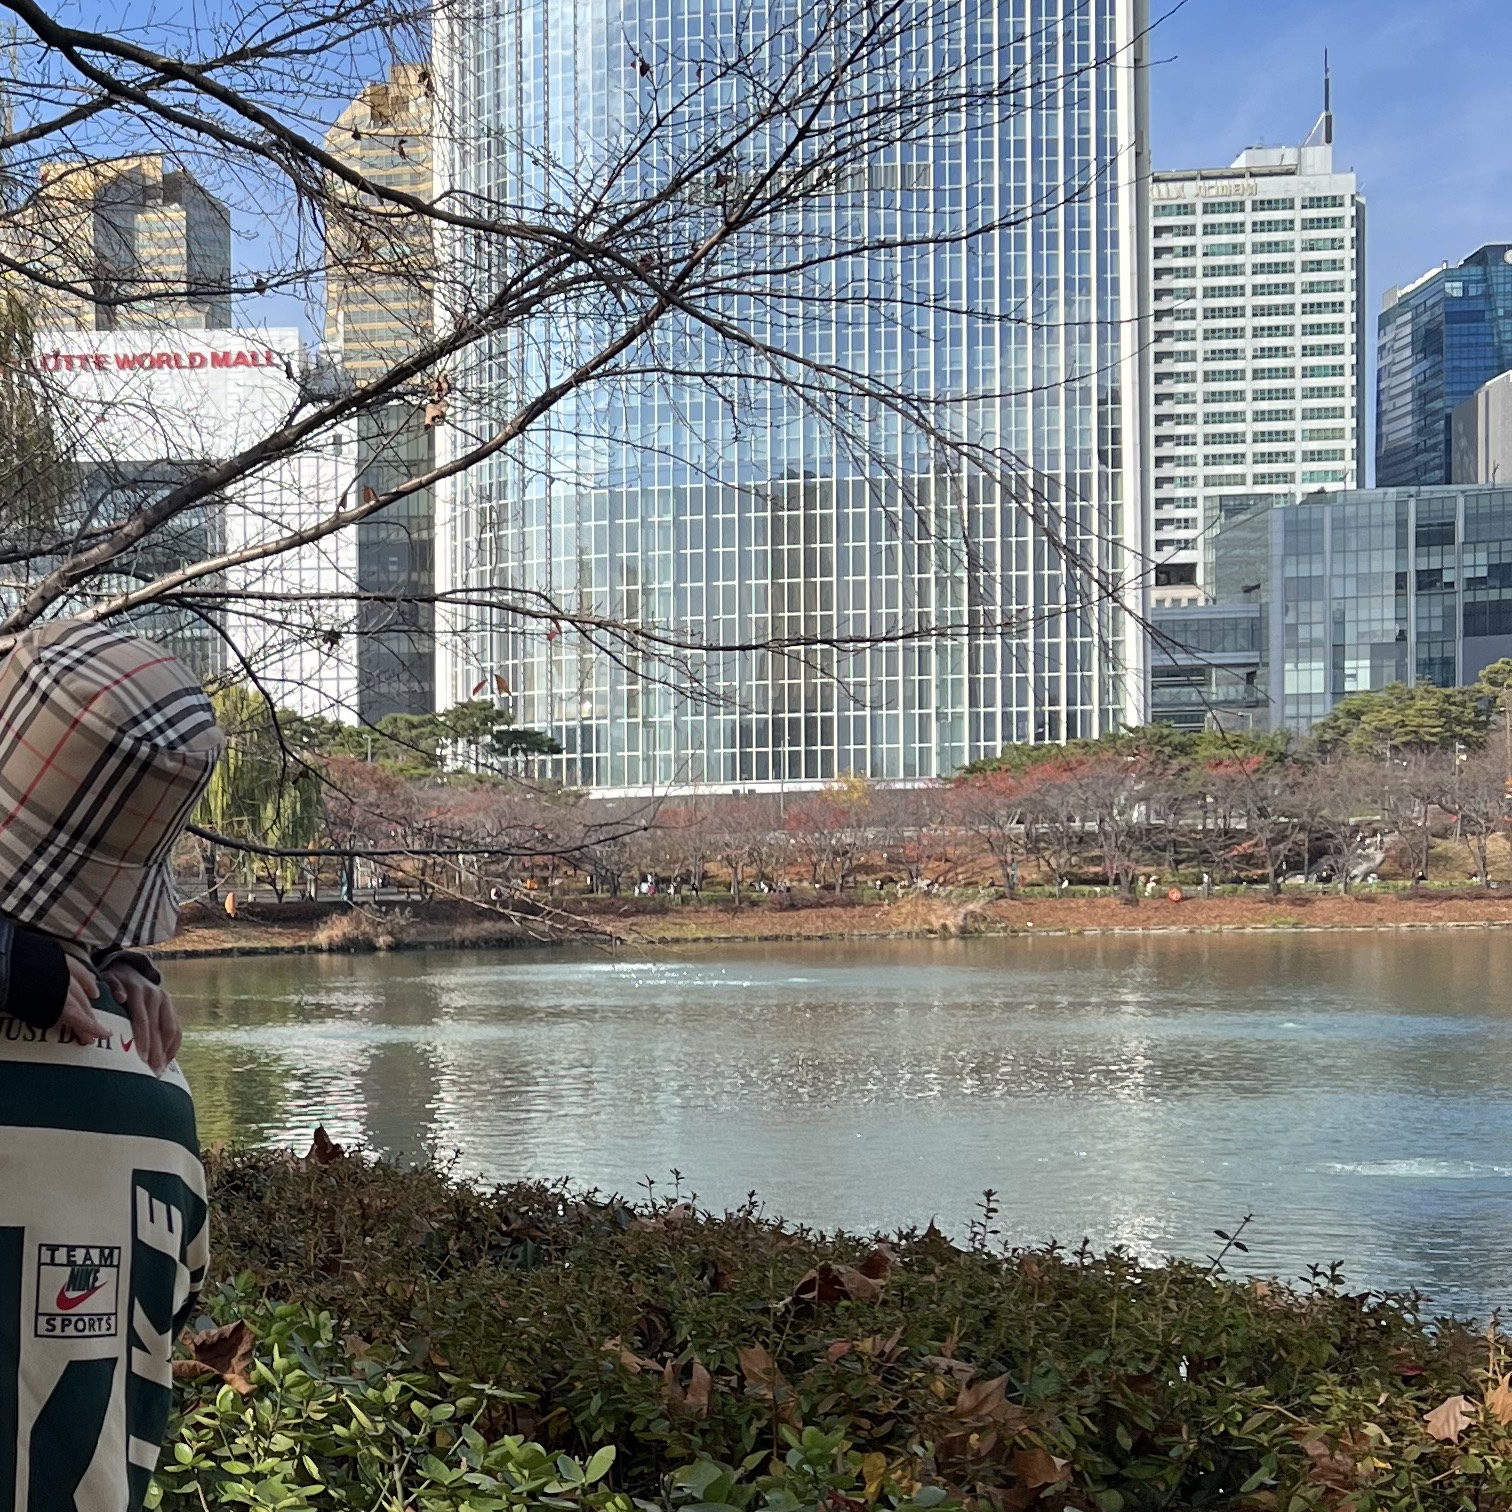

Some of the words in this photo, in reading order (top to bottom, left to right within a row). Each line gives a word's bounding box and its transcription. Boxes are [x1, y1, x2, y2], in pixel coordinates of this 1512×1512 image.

[29, 353, 111, 372] OTTE
[113, 352, 207, 371] WORLD
[210, 350, 284, 368] MALL
[46, 1246, 115, 1265] TEAM
[45, 1316, 112, 1333] SPORTS
